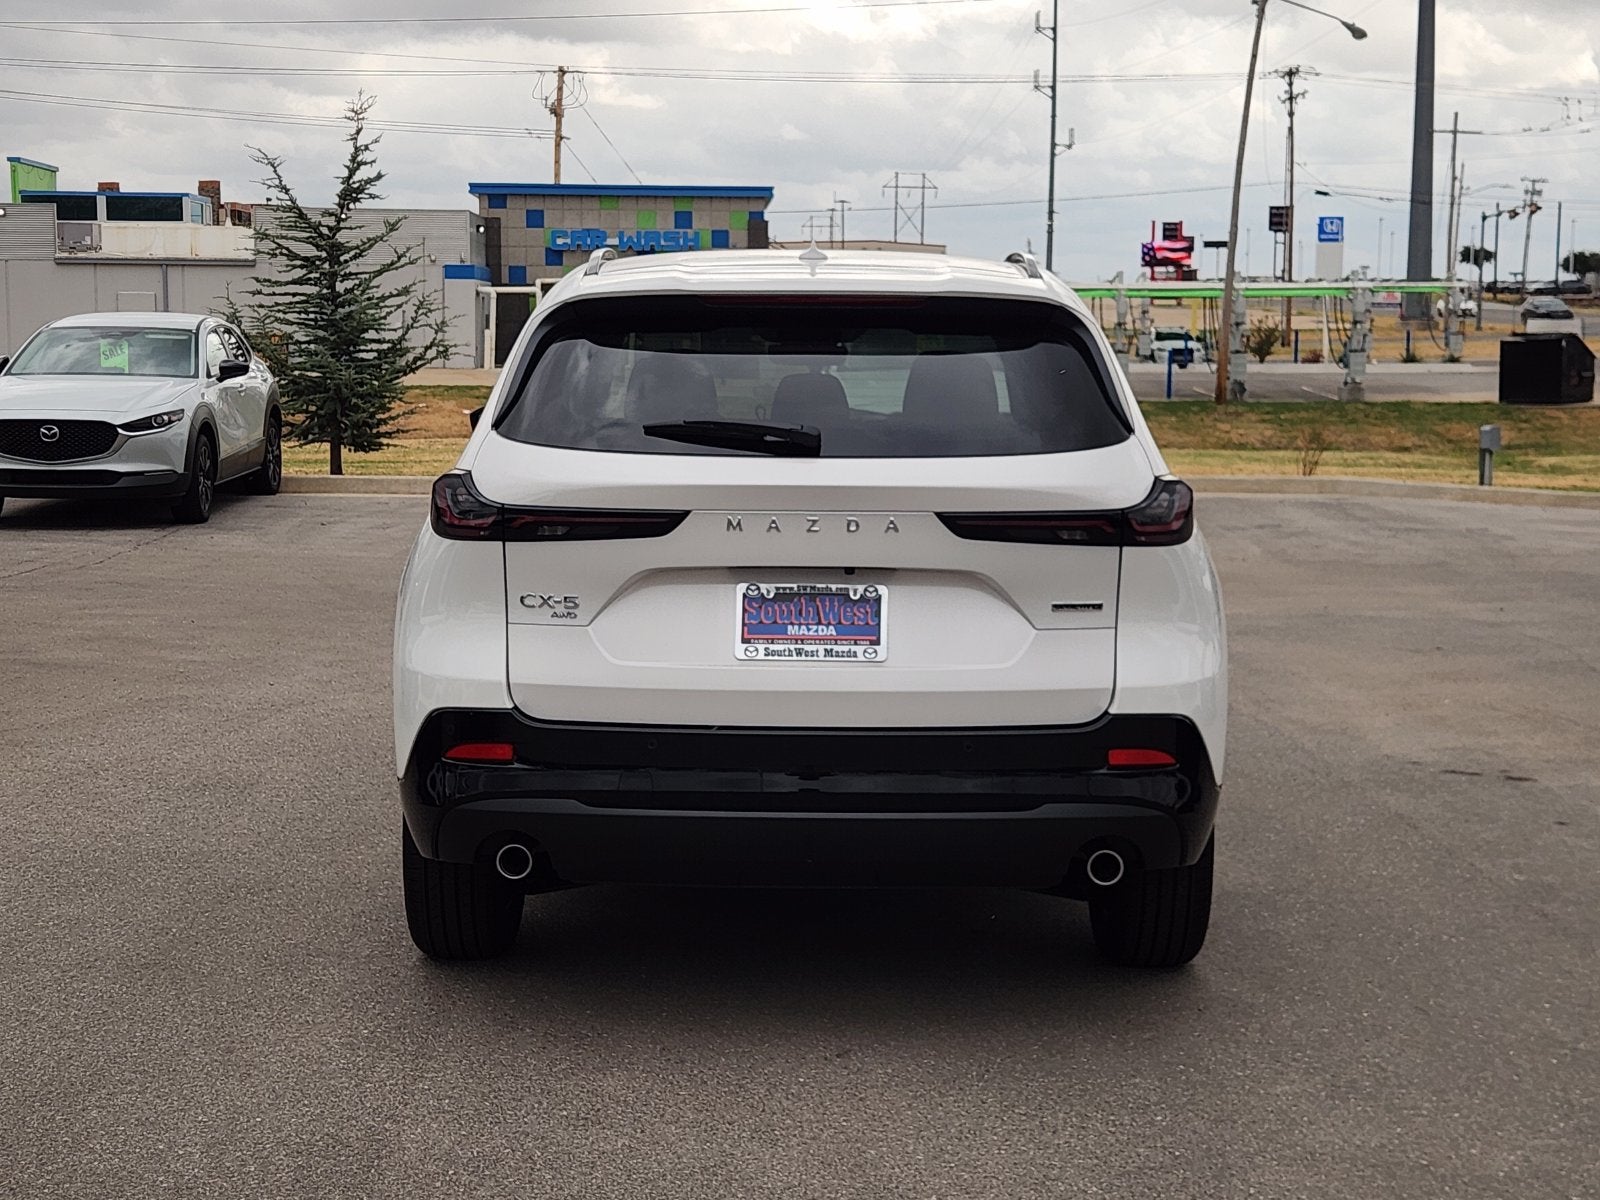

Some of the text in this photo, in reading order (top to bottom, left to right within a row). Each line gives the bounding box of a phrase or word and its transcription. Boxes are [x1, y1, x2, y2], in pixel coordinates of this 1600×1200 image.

[550, 228, 700, 251] CAR WASH
[102, 343, 126, 360] SALE
[726, 515, 900, 534] MAZDA
[519, 592, 580, 610] CX-5
[550, 611, 578, 620] AWD
[745, 595, 878, 625] SouthWest
[787, 624, 837, 636] MAZDA
[763, 646, 858, 659] SouthWest Mazda
